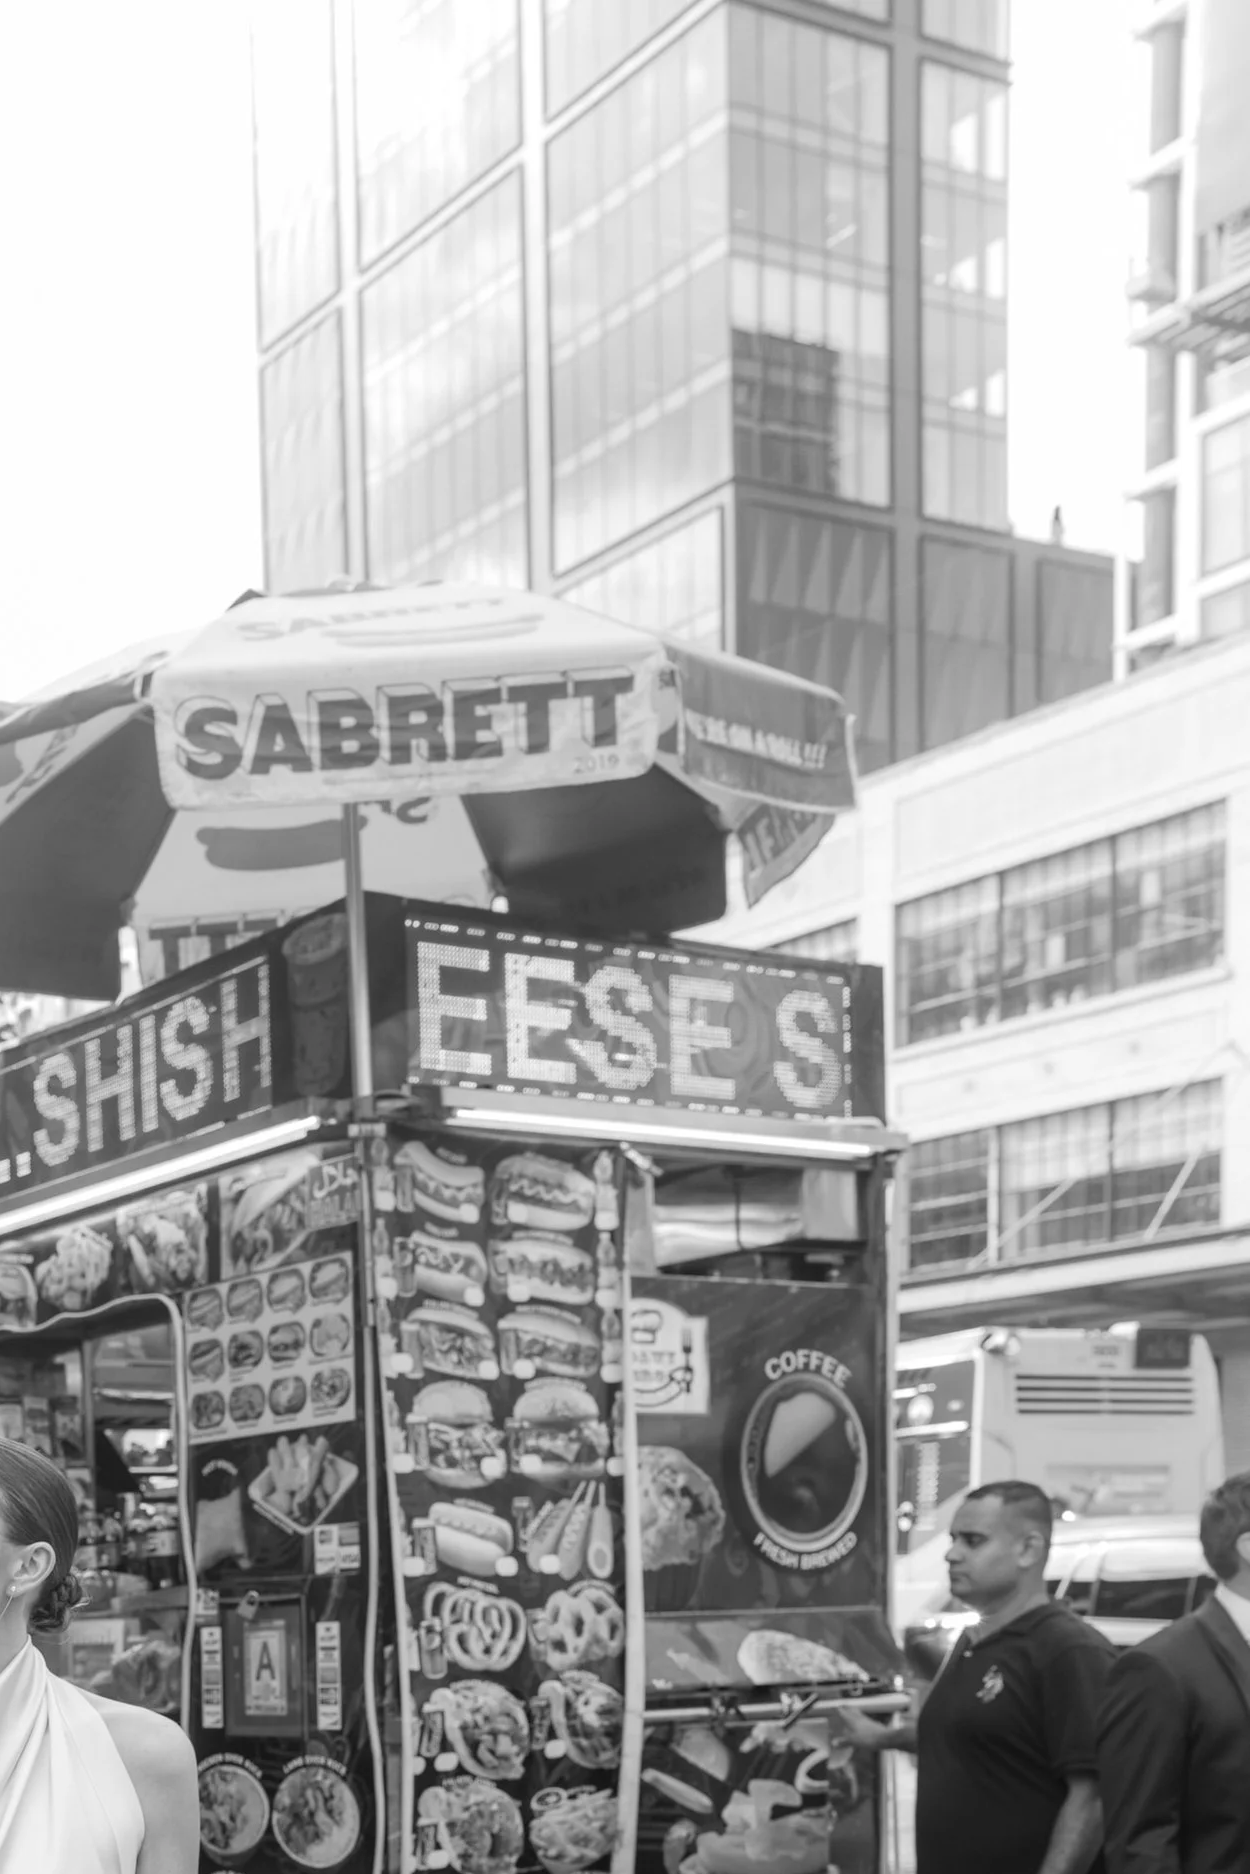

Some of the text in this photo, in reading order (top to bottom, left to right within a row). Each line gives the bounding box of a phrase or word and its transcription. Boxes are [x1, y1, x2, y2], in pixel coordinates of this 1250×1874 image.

[173, 665, 635, 781] SABRETT
[573, 754, 620, 774] 2019
[773, 989, 843, 1109] S
[764, 1347, 852, 1388] COFFEE
[753, 1531, 859, 1571] FRESH BREWED
[256, 1641, 277, 1682] A
